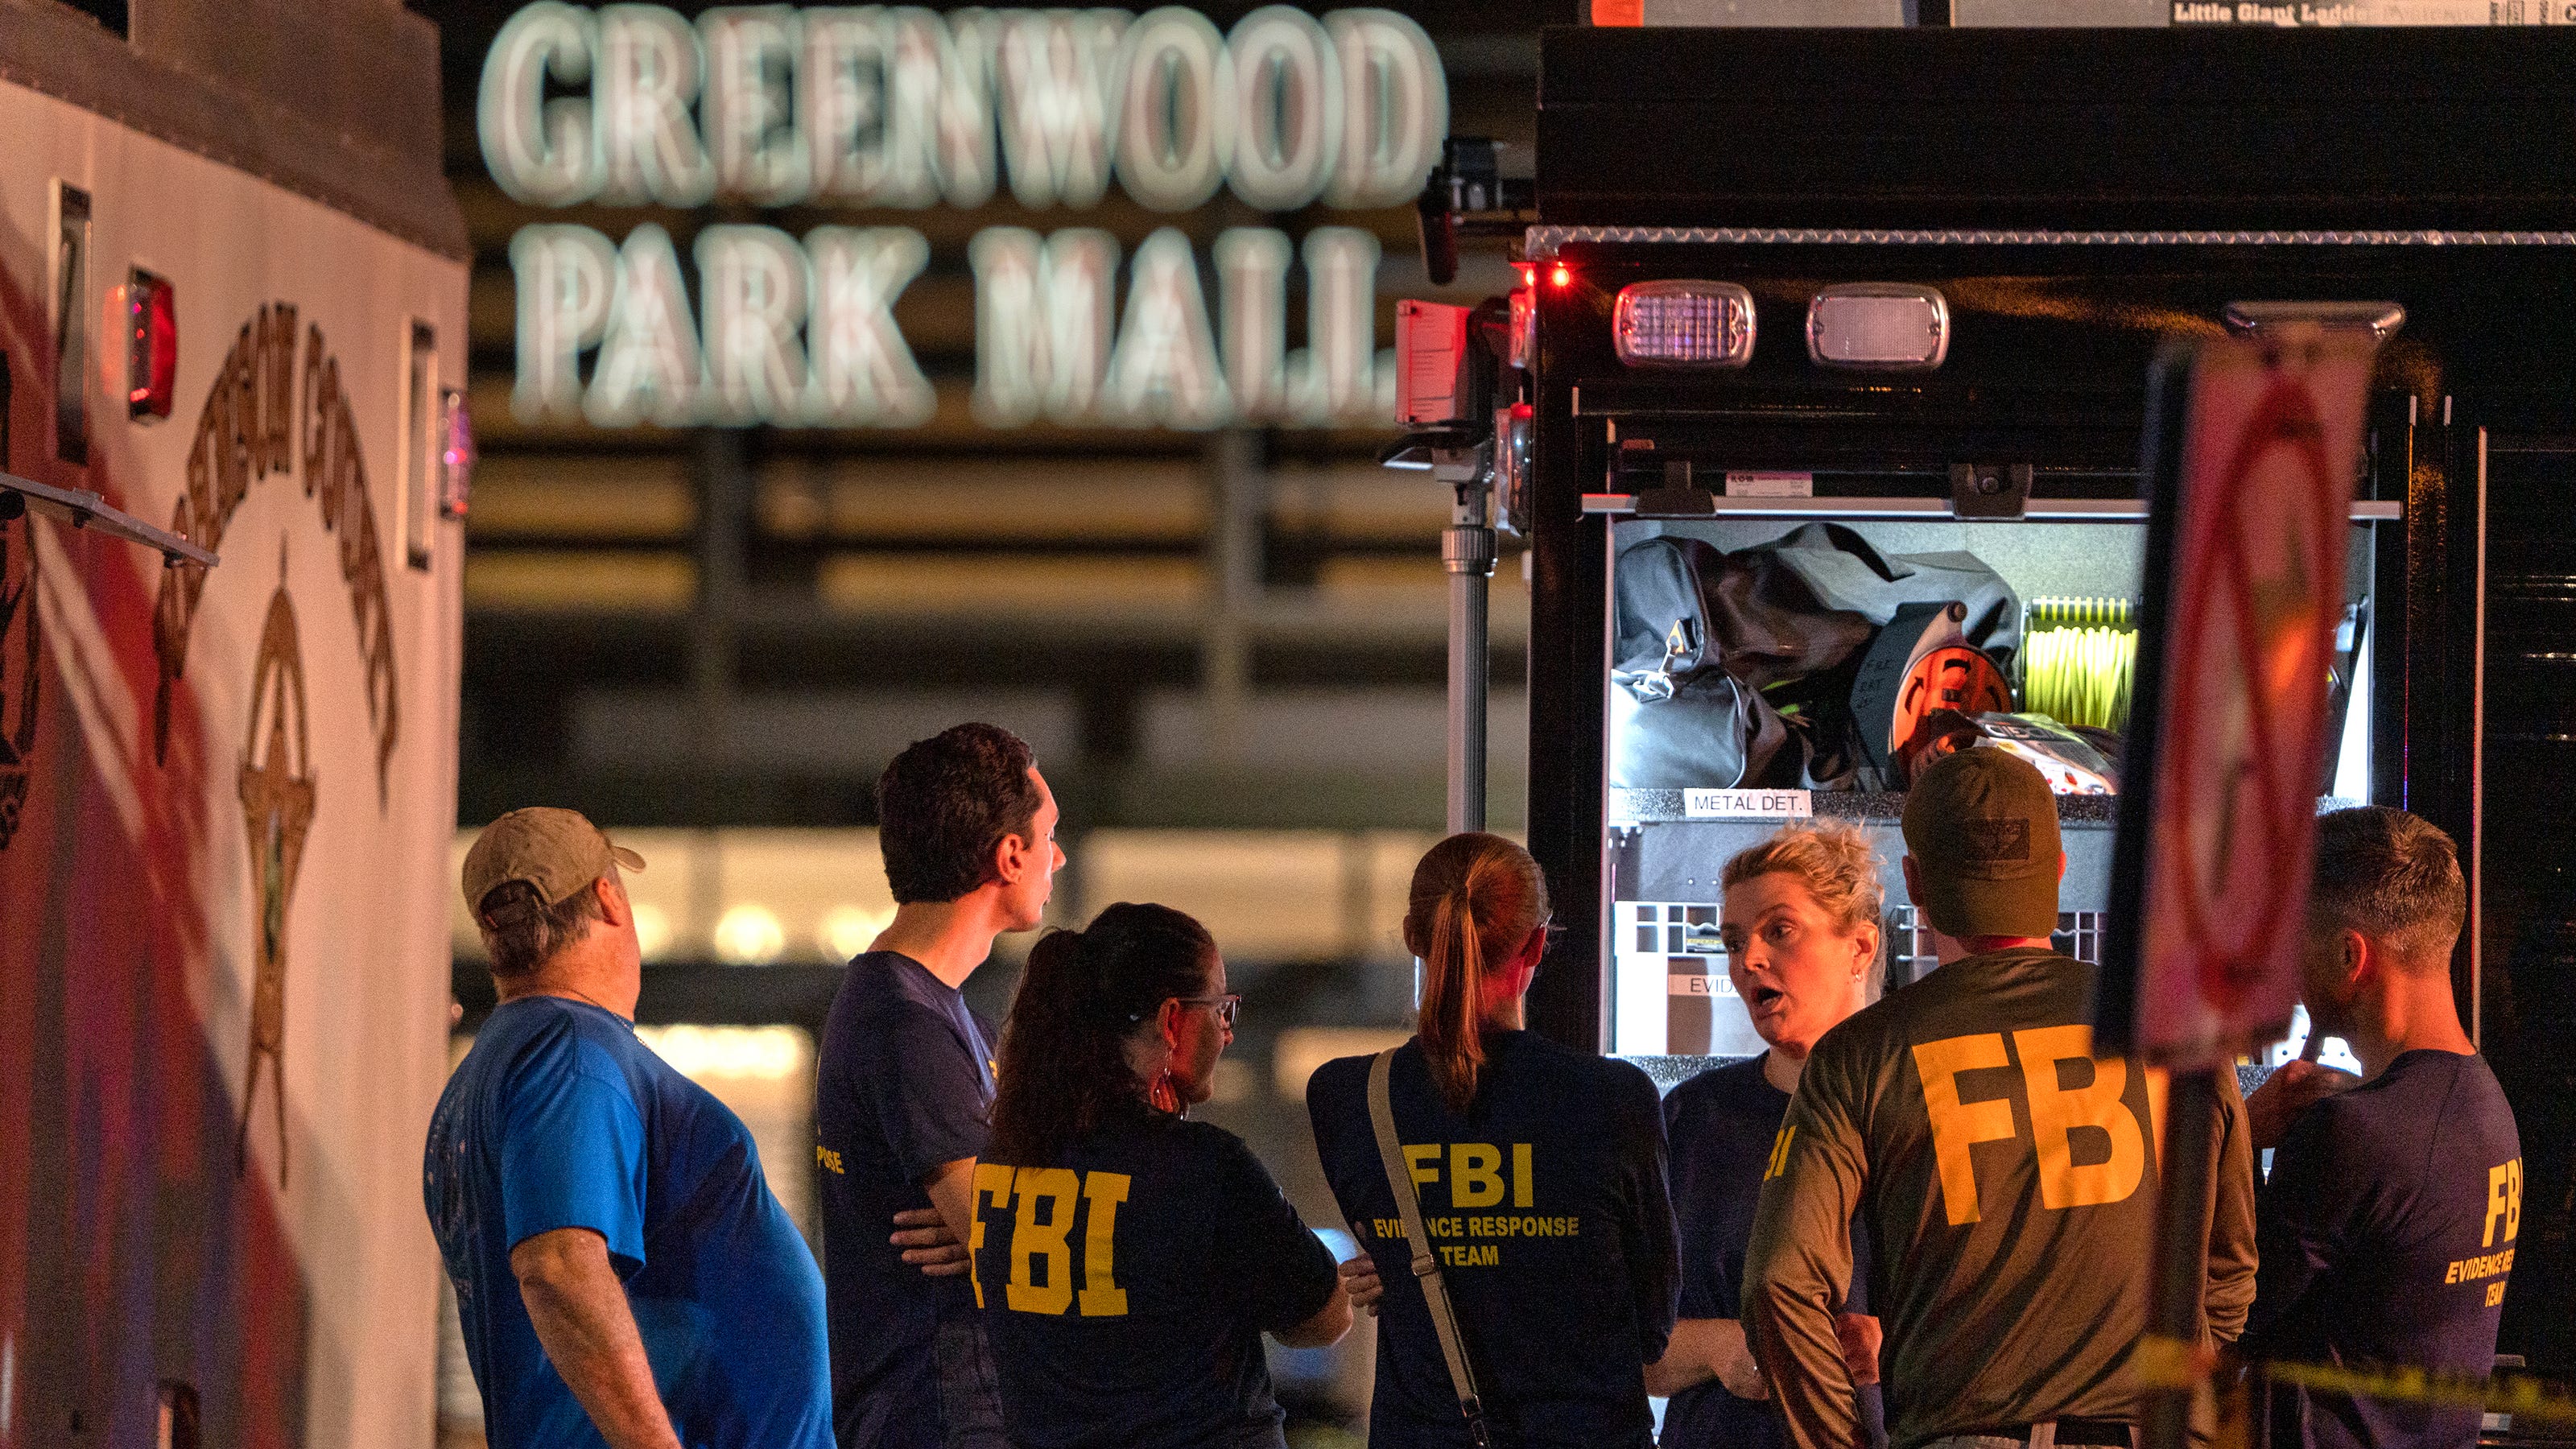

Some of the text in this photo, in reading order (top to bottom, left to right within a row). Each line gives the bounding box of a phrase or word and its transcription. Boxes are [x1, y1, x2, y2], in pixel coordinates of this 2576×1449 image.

[2174, 2, 2232, 22] Little
[2238, 2, 2294, 24] Giant
[478, 2, 1449, 209] GREENWOOD
[509, 224, 937, 428] PARK
[968, 226, 1397, 429] MALL
[1695, 795, 1802, 811] METAL DET.
[1402, 1143, 1534, 1208] FBI
[2482, 1156, 2523, 1248] FB
[969, 1162, 1131, 1316] FBI
[1374, 1216, 1579, 1238] EVINCE RESPONSE
[1440, 1245, 1499, 1266] TEAM
[2444, 1252, 2504, 1284] EVIDENCE
